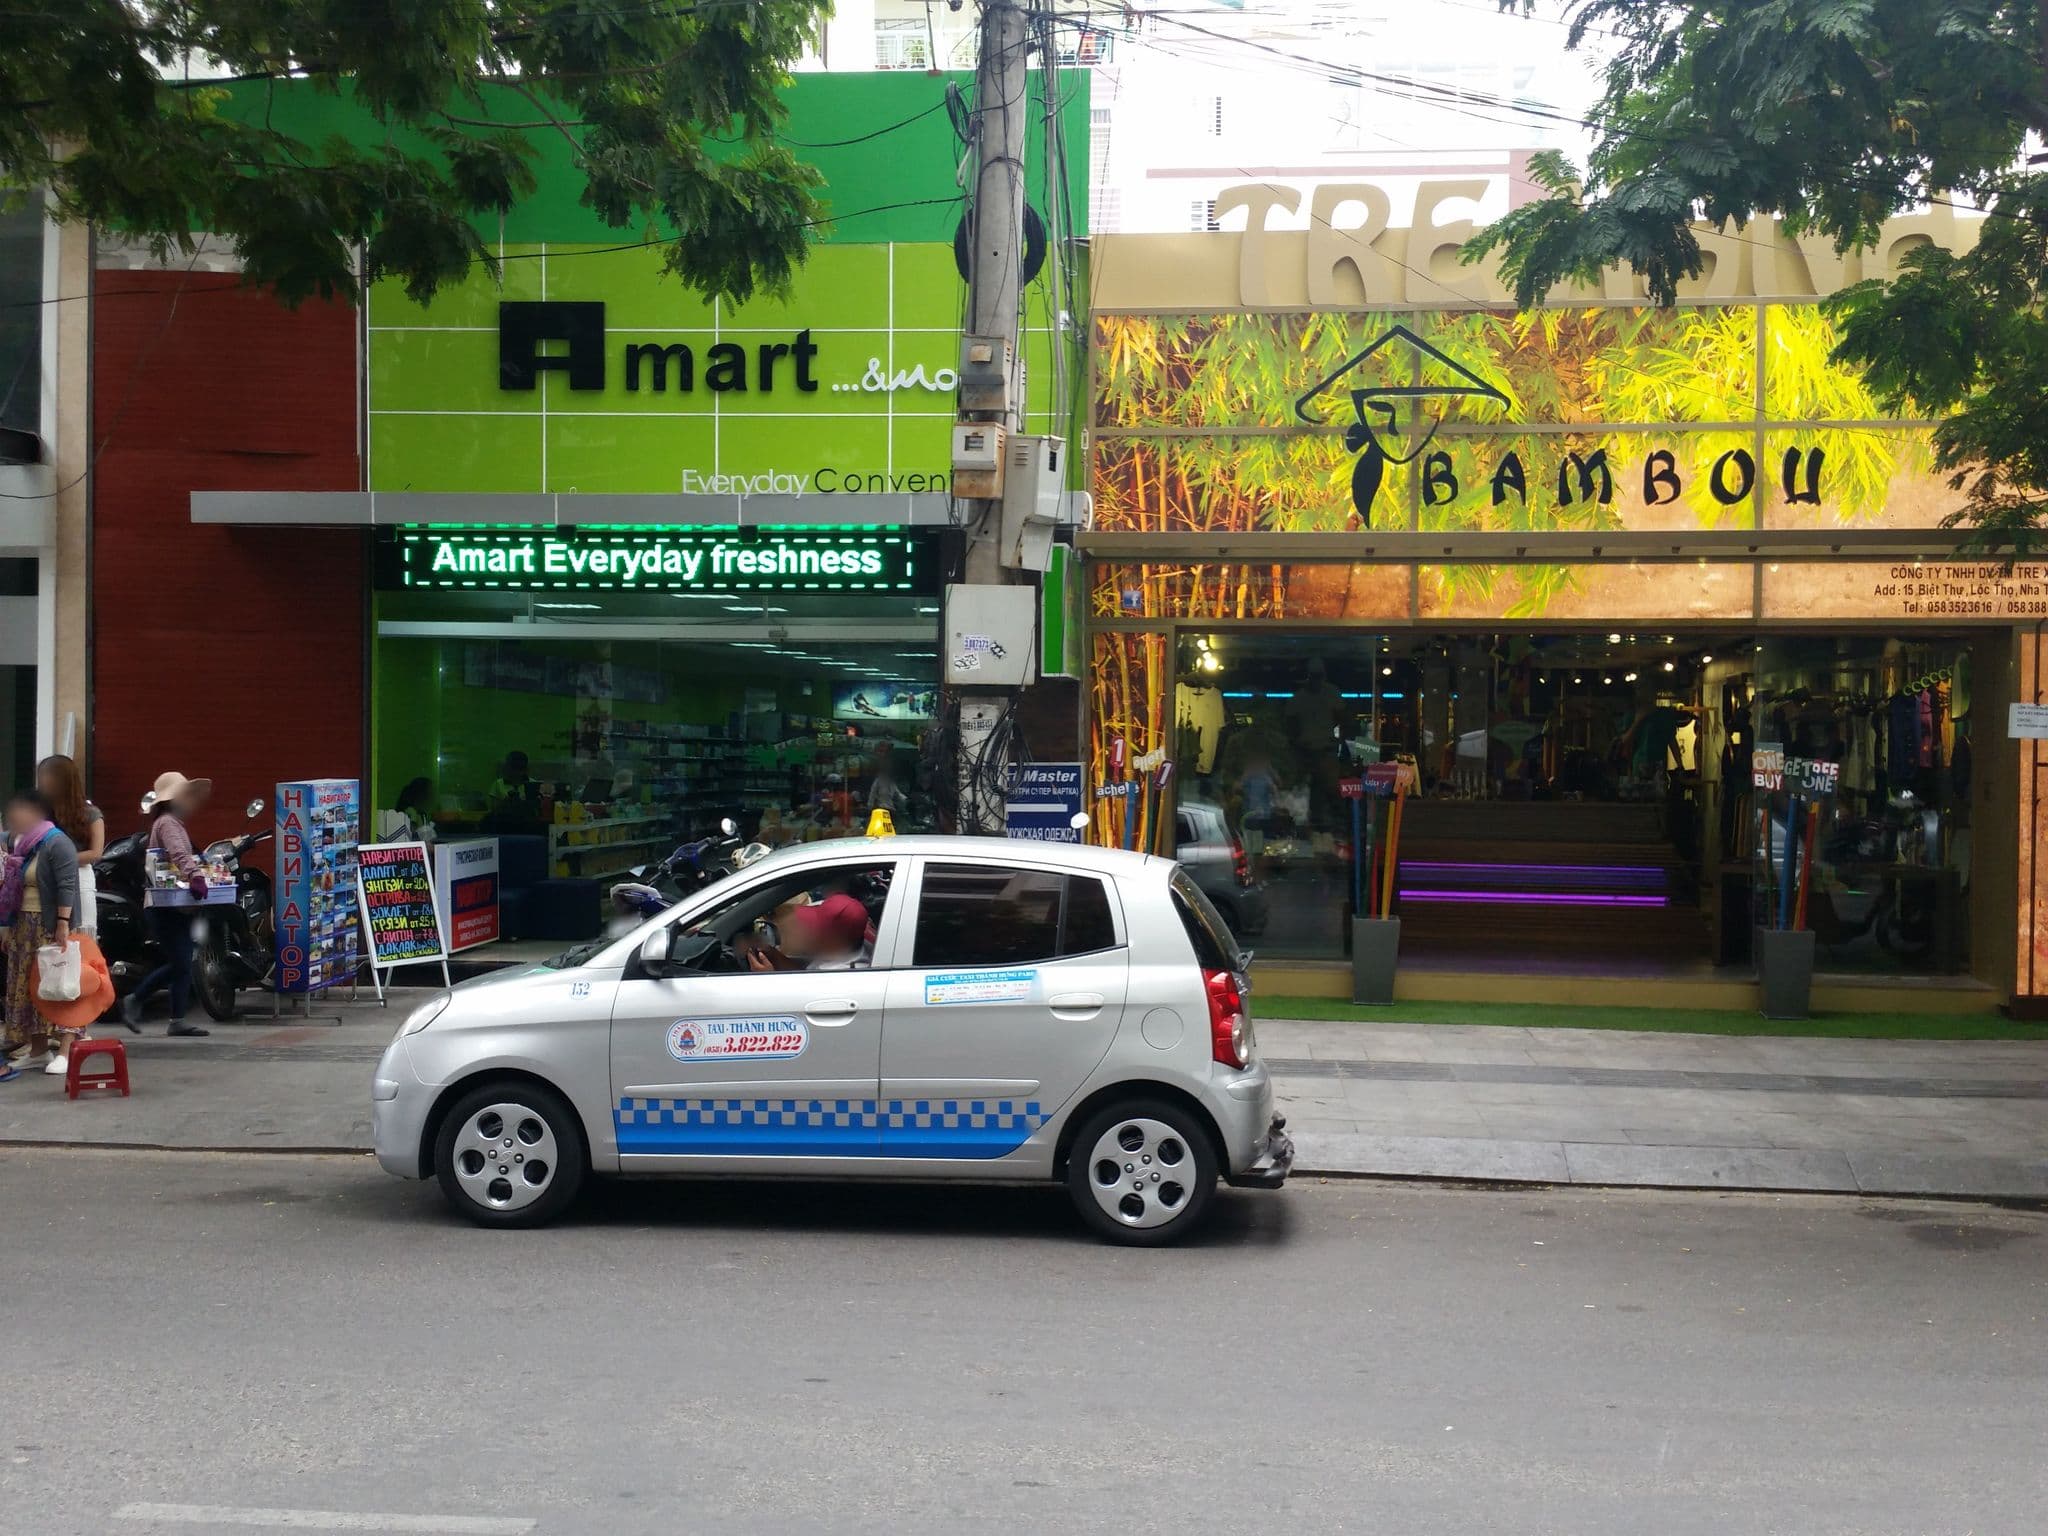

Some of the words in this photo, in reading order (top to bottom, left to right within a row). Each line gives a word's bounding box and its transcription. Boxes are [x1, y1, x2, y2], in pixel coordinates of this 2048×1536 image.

[1213, 179, 1490, 303] TRE
[626, 329, 817, 392] mart
[682, 469, 808, 499] Everyday
[1422, 446, 1825, 508] BAMBOU
[432, 541, 534, 574] Amart
[544, 543, 703, 580] Everyday
[711, 543, 882, 574] freshness
[1926, 567, 1942, 579] TY
[1945, 567, 1975, 579] TNHH
[2017, 566, 2039, 579] TRE
[1904, 584, 1913, 595] 15
[1918, 583, 1939, 598] Biệt
[2020, 584, 2040, 595] Nha
[1023, 770, 1077, 782] Master
[1754, 774, 1783, 790] BUY
[280, 788, 304, 988] НАВИГАТОР
[372, 917, 408, 932] ГРЯЗИ
[572, 982, 590, 996] 152
[708, 1024, 724, 1034] TAXI
[730, 1020, 765, 1033] THÀNH
[724, 1035, 802, 1053] 3.822.822
